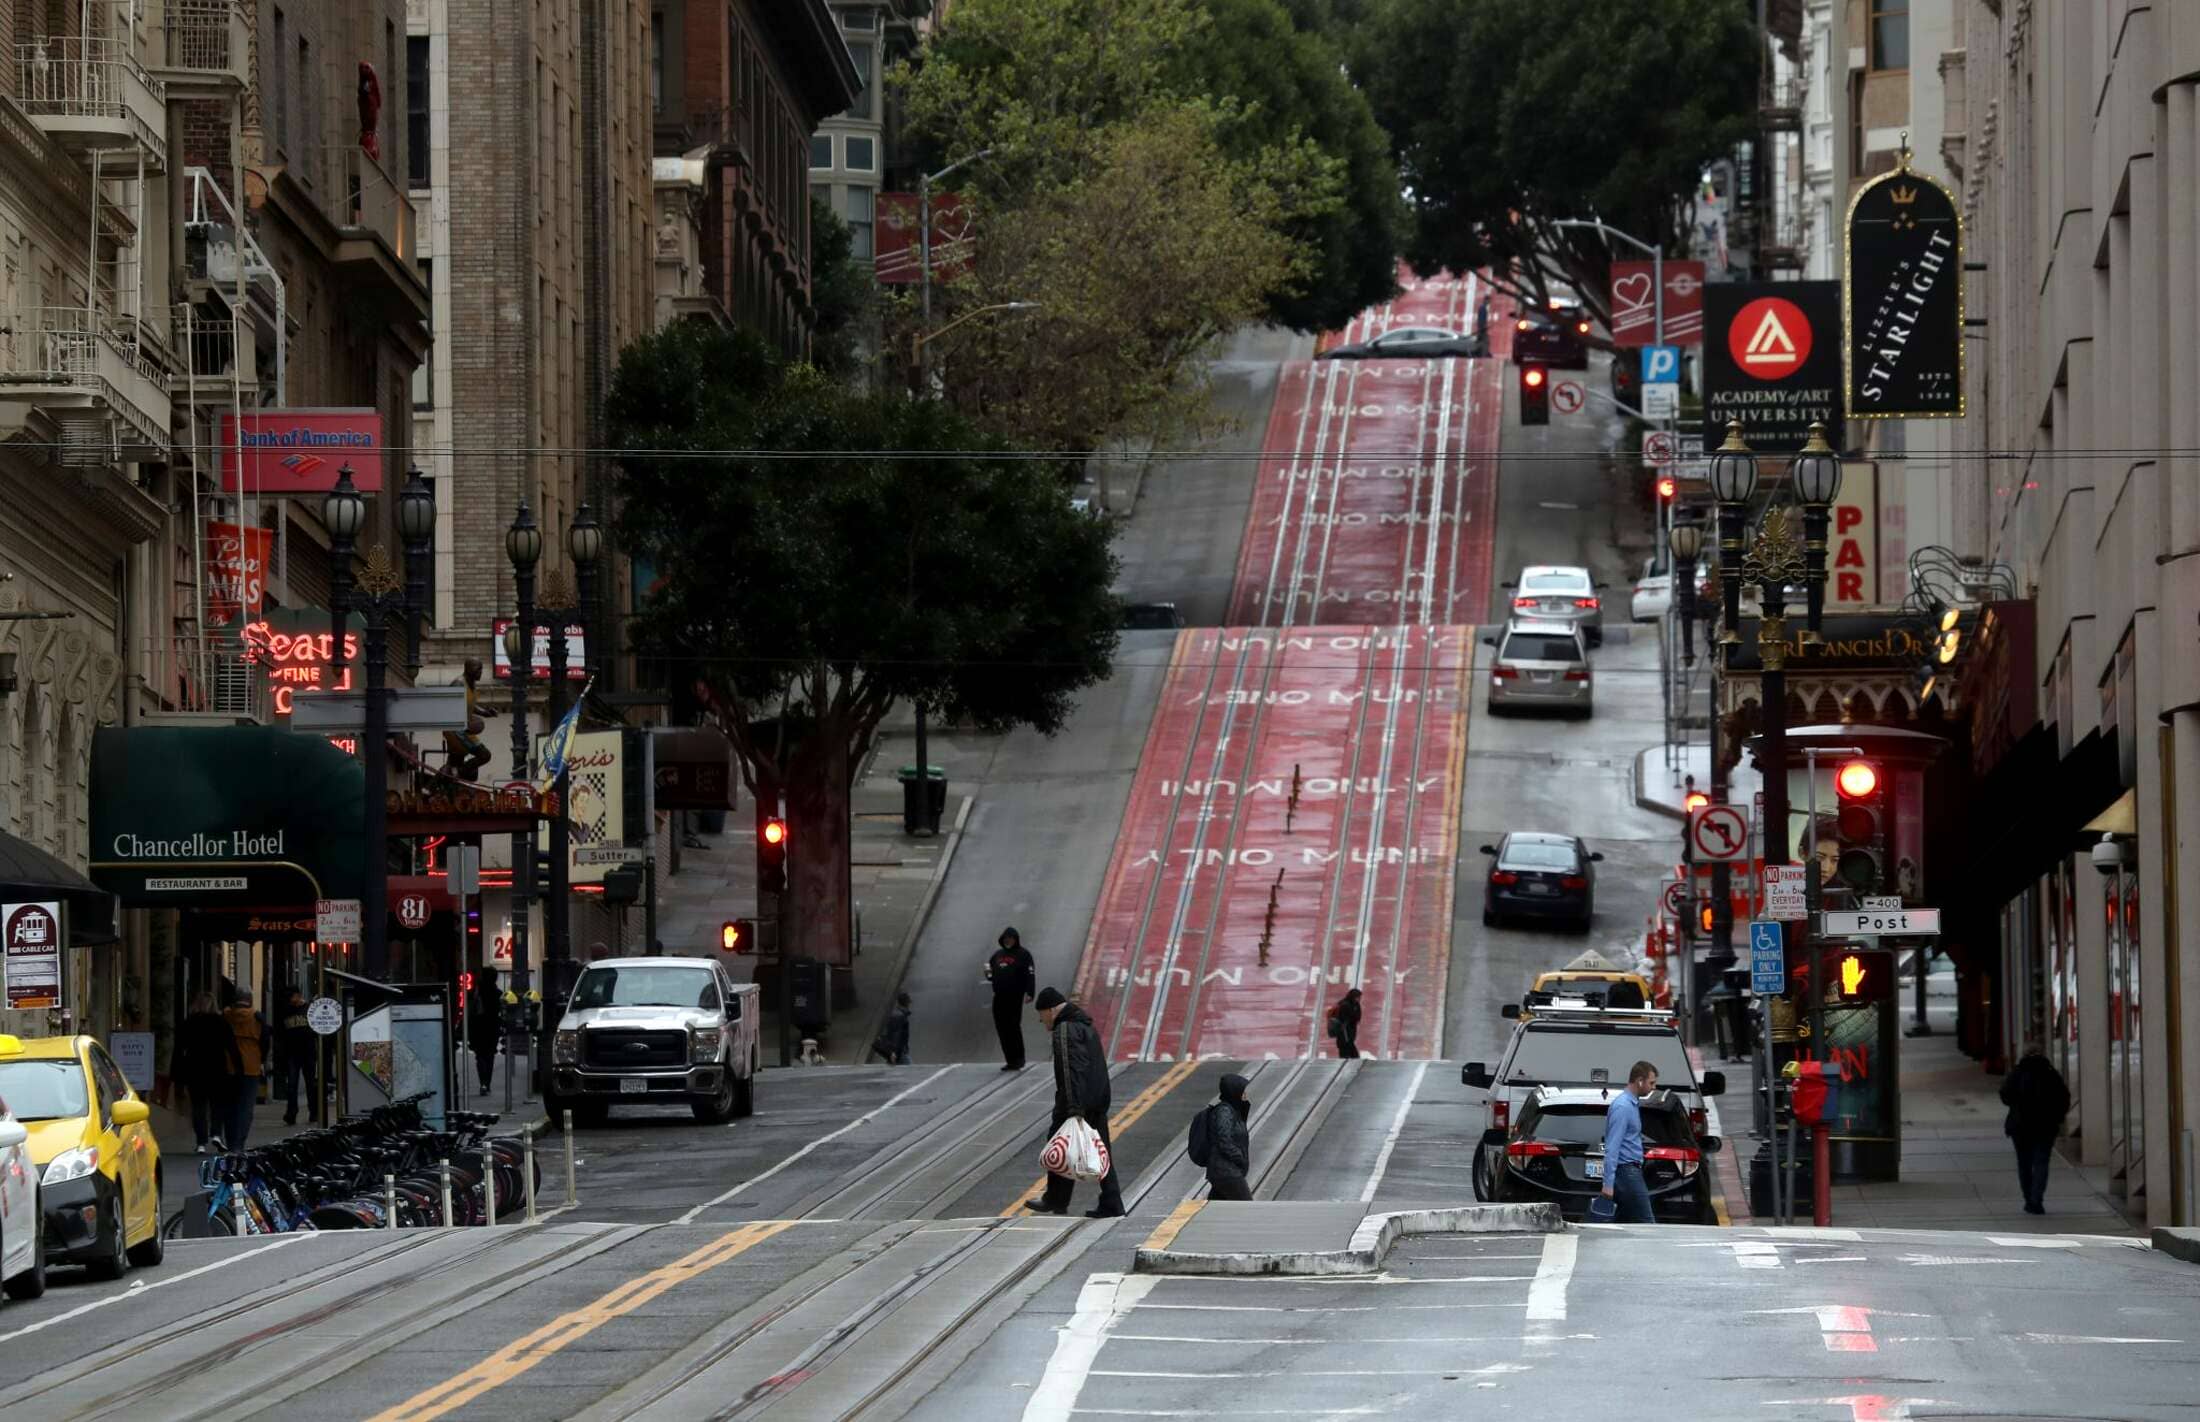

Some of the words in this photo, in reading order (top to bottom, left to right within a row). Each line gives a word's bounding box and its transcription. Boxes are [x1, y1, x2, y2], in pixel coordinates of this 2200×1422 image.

[1862, 260, 1910, 351] LIZZIE'S
[1861, 229, 1951, 402] STARLIGHT
[1711, 390, 1787, 404] ACADEMY
[1801, 389, 1832, 402] ART
[1711, 407, 1832, 421] UNIVERSITY
[240, 428, 281, 447] Bank
[282, 427, 299, 447] of
[301, 428, 373, 447] America
[240, 622, 358, 664] Sears
[284, 667, 320, 682] FINE
[1161, 779, 1282, 796] MUNI
[114, 833, 227, 857] Chancellor
[232, 829, 285, 856] Hotel
[591, 852, 629, 861] Sutter
[1767, 868, 1778, 882] NO
[1780, 872, 1806, 881] PARKIN
[151, 879, 212, 889] RESTAURANT
[214, 879, 222, 888] &
[224, 879, 243, 888] BAR
[317, 901, 330, 914] NO
[332, 903, 359, 913] PARKING
[402, 898, 425, 919] 81
[1878, 899, 1899, 908] 400
[1858, 915, 1908, 930] Post
[22, 945, 41, 953] CABLE
[42, 944, 55, 953] CAR
[1753, 951, 1780, 961] PARKING
